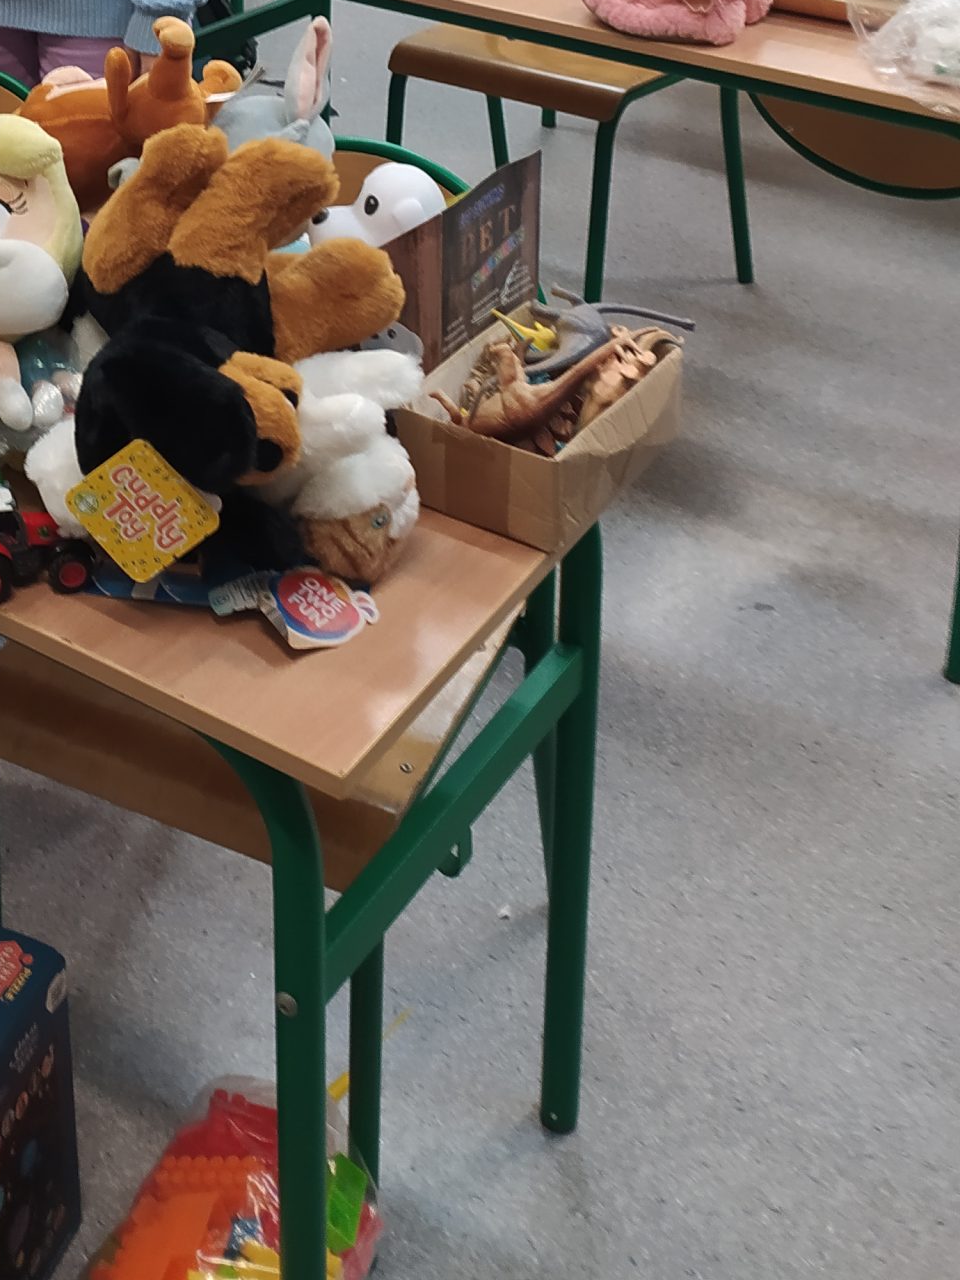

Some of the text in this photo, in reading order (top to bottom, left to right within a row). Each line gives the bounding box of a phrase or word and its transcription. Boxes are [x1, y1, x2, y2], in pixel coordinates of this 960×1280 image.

[104, 490, 149, 540] Toy
[111, 465, 187, 551] Cuddly
[287, 592, 330, 629] FUN
[297, 582, 338, 620] TWO
[304, 577, 348, 613] ONE
